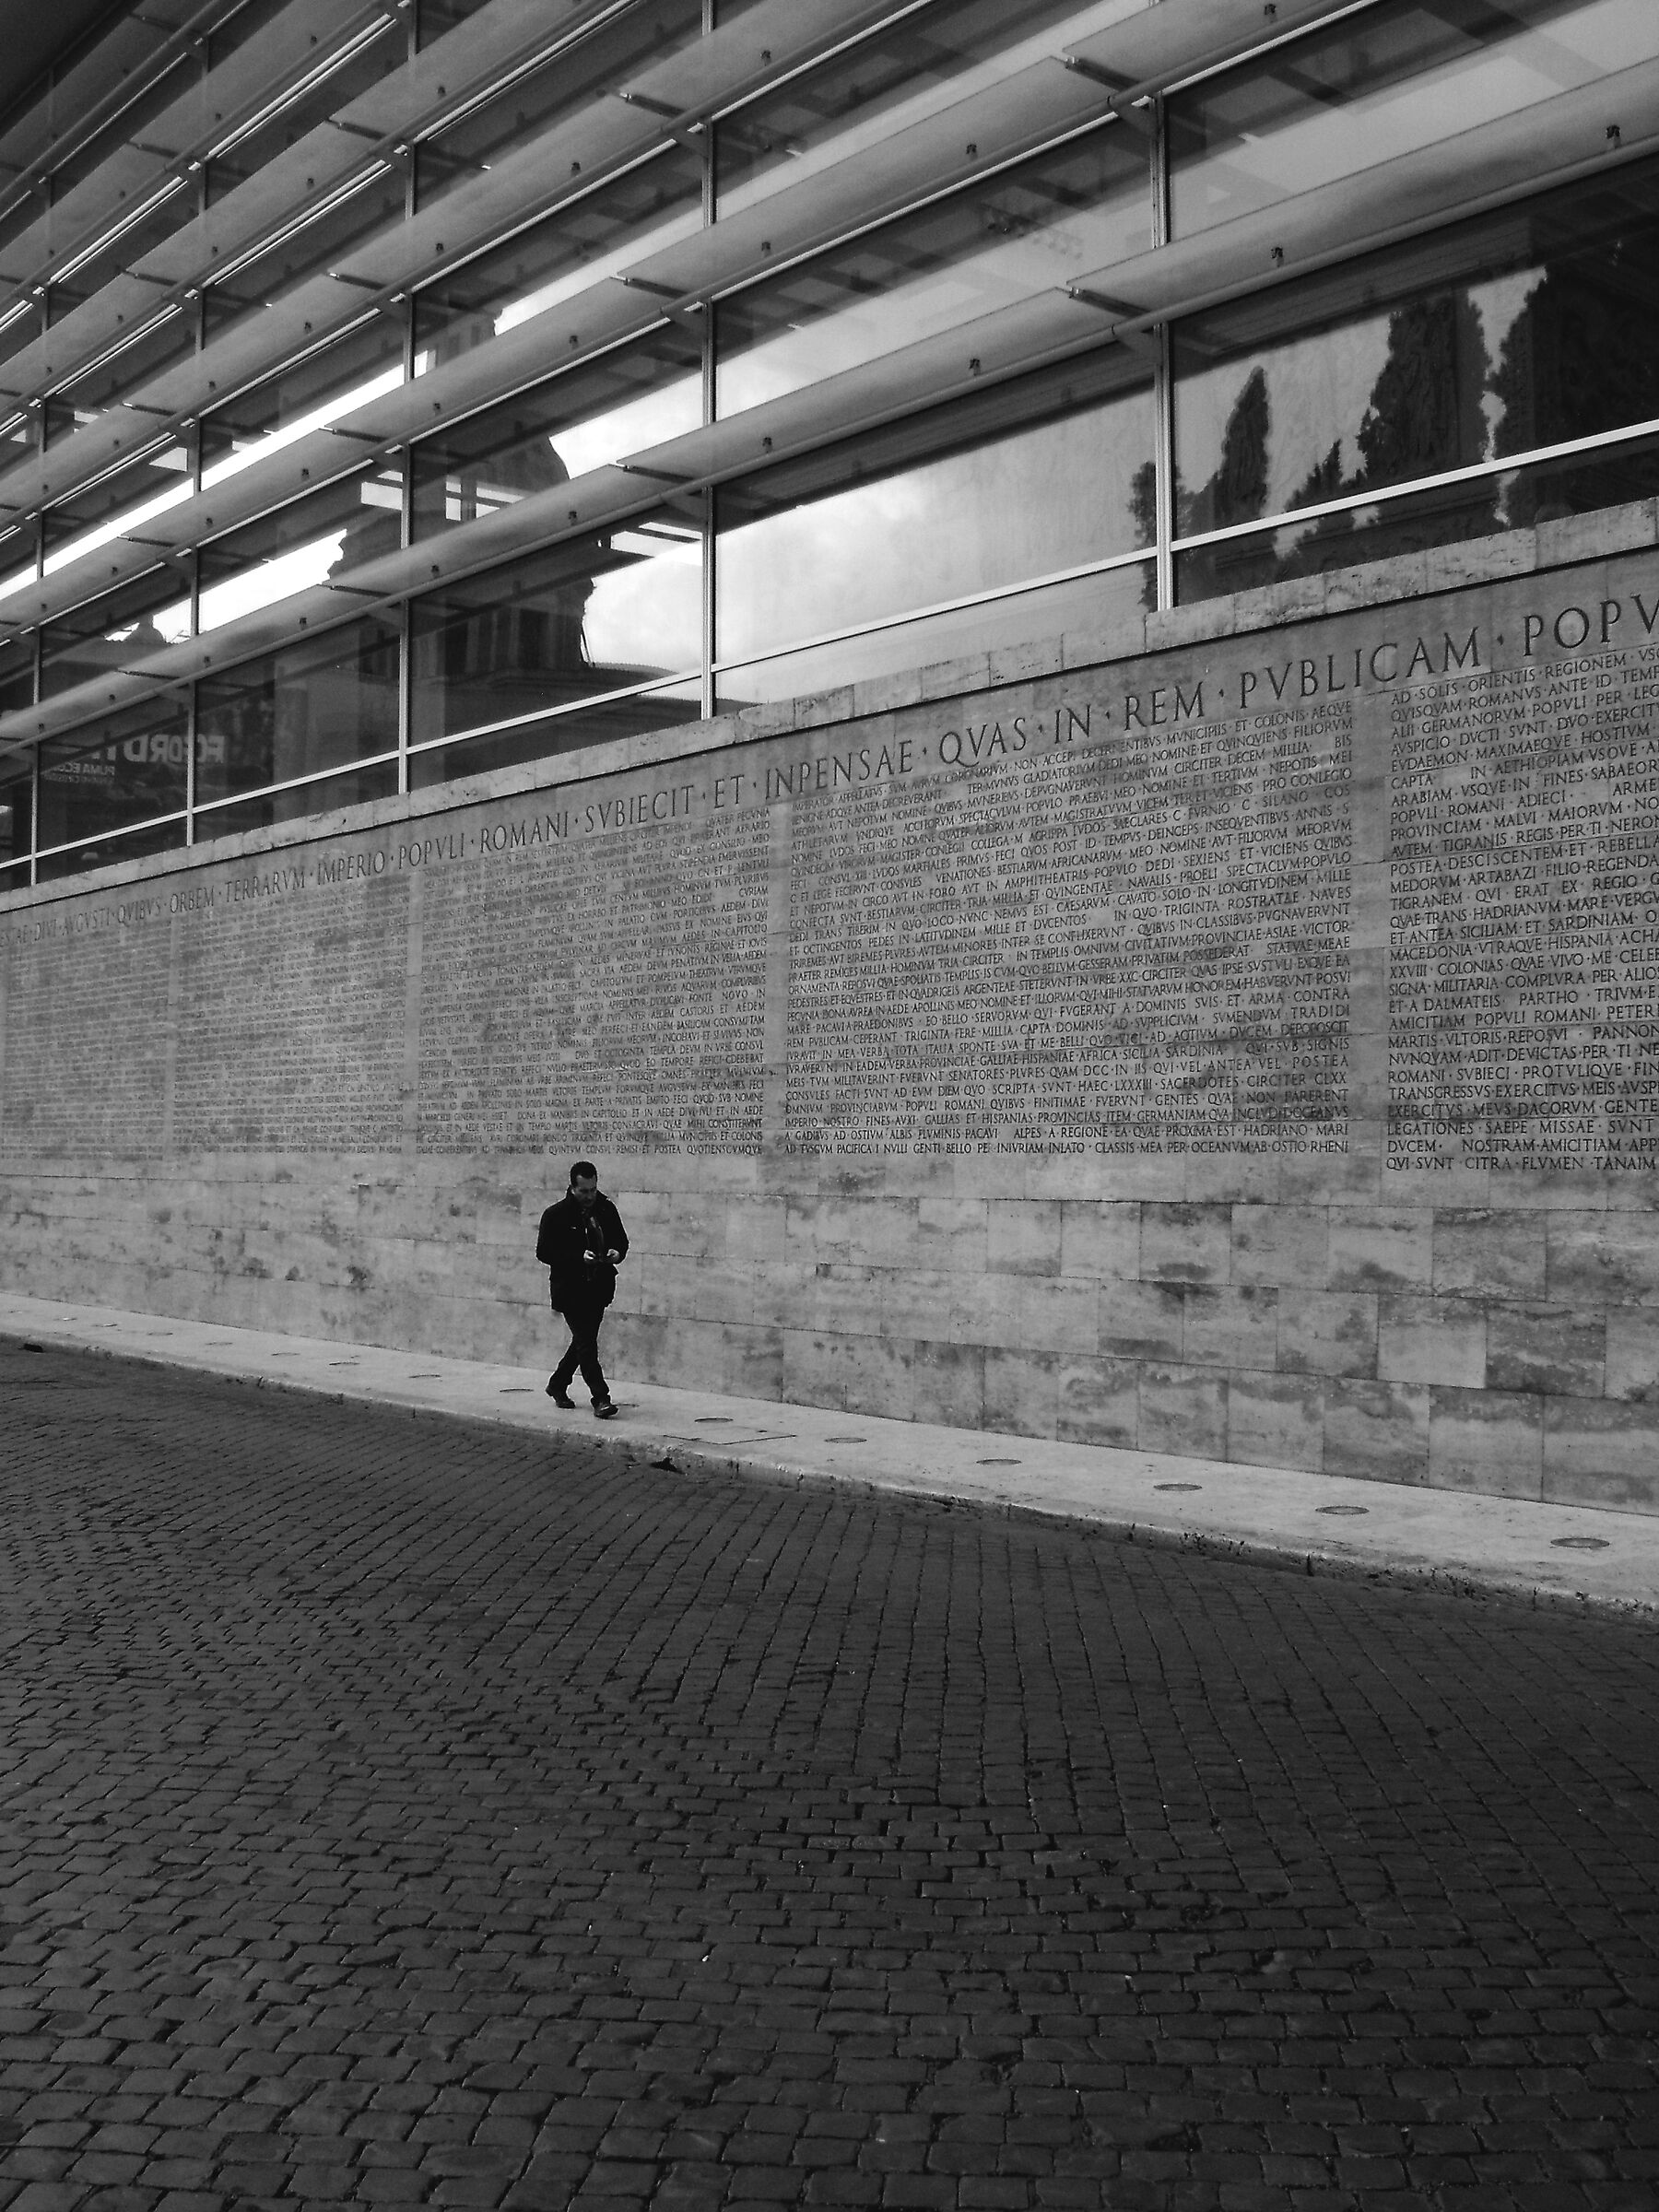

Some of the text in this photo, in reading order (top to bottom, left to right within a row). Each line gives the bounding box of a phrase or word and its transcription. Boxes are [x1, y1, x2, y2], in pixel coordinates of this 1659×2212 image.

[1391, 651, 1626, 706] AD SOLIS ORIENTIS REGIONEM
[1391, 672, 1611, 725] QVISQVAM ROMANVS ANTE ID
[1392, 688, 1621, 740] ALII GERMANORVM POPVLI PER
[1235, 719, 1247, 733] ET
[1253, 709, 1304, 730] COLONIS
[1312, 700, 1351, 720] AEQVE
[1152, 717, 1352, 763] NOMINE ET QVINQVIENS FILIORVM
[1391, 712, 1588, 758] AVSPICIO DVCTI SVNT DVO
[118, 897, 160, 927] QVIBVS
[170, 886, 215, 913] ORBEM
[225, 867, 305, 902] TERRARVM
[318, 851, 385, 885] IMPERIO
[398, 832, 465, 869] POPVLI
[480, 811, 569, 853] ROMANI
[583, 784, 694, 833] SVBIECIT
[713, 774, 745, 809] ET
[765, 739, 913, 799] INPENSAE
[938, 717, 1028, 769] QVAS
[1053, 704, 1092, 745] IN
[1124, 682, 1206, 731] REM
[1240, 626, 1483, 710] PVBLICAM
[1391, 768, 1583, 808] ARABIAM VSQVE IN FINES
[1390, 788, 1565, 825] POPVLI ROMANI ADIECI
[1390, 799, 1622, 841] PROVINCIAM MALVI MAIORVM
[1147, 804, 1332, 841] DEINCEPS INSEQVENTIBVS ANNIS
[1051, 818, 1352, 868] AFRICANARVM MEO NOMINE AVT FILIORVM MEORVM
[1390, 841, 1586, 877] POSTEA DESCISCENTEM ET
[1316, 868, 1350, 885] MILLE
[1390, 860, 1580, 894] MEDORVM ARTABAZI FILIO
[1164, 885, 1350, 916] TRIGINTA NAVES
[1390, 894, 1608, 931] QVAE TRANS HADRIANVM MARE
[1390, 931, 1611, 963] MACEDONIA VTRAQVE HISPANIA
[1389, 967, 1618, 997] SIGNA MILITARIA COMPLVRA PER
[1059, 987, 1349, 1018] FVGERANT DOMINIS SVIS ET ARMA CONTRA
[1290, 1004, 1349, 1019] TRADIDI
[1389, 983, 1642, 1014] ET A DALMATEIS PARTHO TRIVM
[1389, 1006, 1595, 1031] AMICITIAM POPVLI ROMANI
[1388, 1027, 1567, 1049] MARTIS VLTORIS REPOSVI
[1153, 1054, 1348, 1076] QVI VEL POSTEA
[1388, 1041, 1630, 1068] NVNQVAM ADIT DEVICTAS PER TI
[1041, 1081, 1071, 1093] SVNT
[1077, 1079, 1107, 1092] HAEC
[1246, 1073, 1305, 1087] CIRCITER
[1314, 1071, 1347, 1085] CLXX
[1387, 1061, 1622, 1084] ROMANI SVBIECI PROTVLIQVE
[1387, 1080, 1615, 1100] TRANSGRESSVS EXERCITVS MEIS
[865, 1115, 889, 1125] FINES
[1387, 1117, 1654, 1136] LEGATIONES SAEPE MISSAE SVNT
[1095, 1140, 1348, 1153] CLASSIS MEA PER OCEANVM OSTIO RHENI
[1387, 1136, 1620, 1153] DVCEM NOSTRAM AMICITIAM
[1386, 1155, 1655, 1171] QVI SVNT CITRA FLVMEN TANAIM
